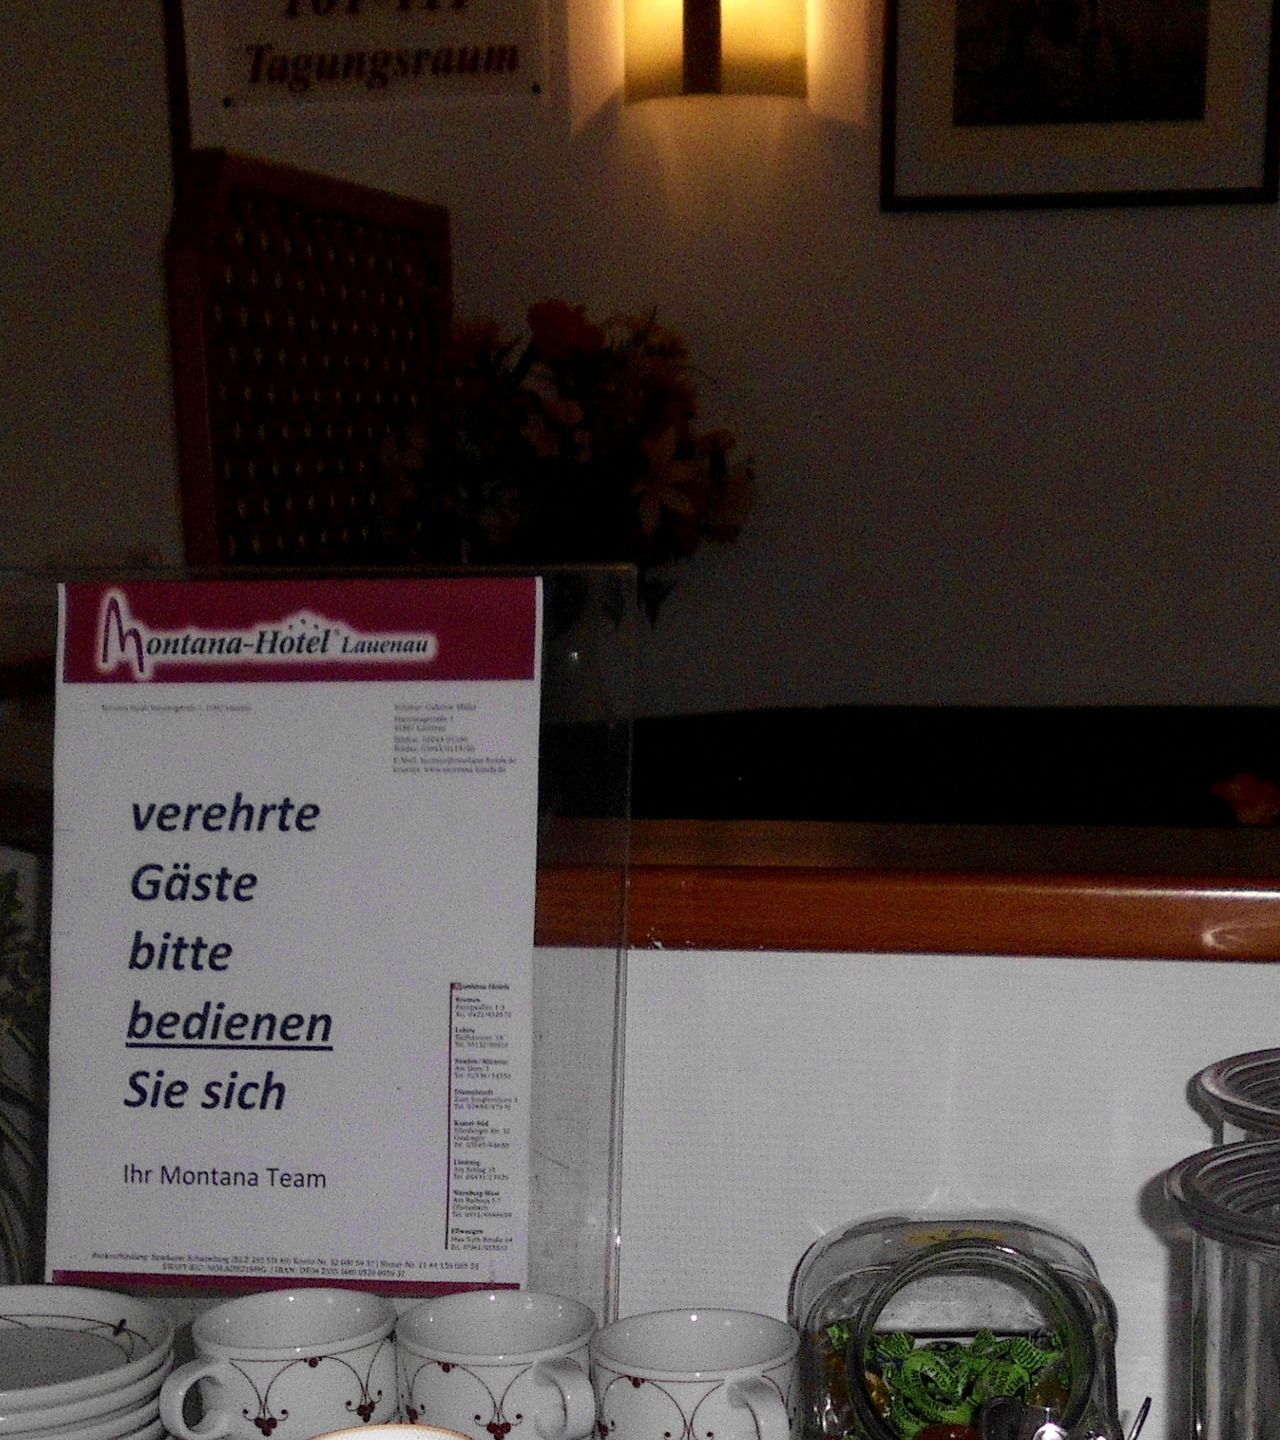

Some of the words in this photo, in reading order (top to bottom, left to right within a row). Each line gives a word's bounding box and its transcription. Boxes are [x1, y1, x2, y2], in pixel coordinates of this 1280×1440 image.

[246, 42, 519, 93] Tagungsraum
[102, 596, 331, 673] Montana-Hotel
[341, 634, 429, 655] Lauenau
[131, 791, 321, 833] verehrte
[130, 862, 258, 903] Gäste
[127, 929, 234, 972] bitte
[125, 999, 333, 1043] bedienen
[122, 1069, 190, 1110] Sie
[200, 1070, 286, 1111] sich
[123, 1163, 153, 1184] Ihr
[160, 1164, 259, 1188] Montana
[265, 1167, 327, 1189] Team
